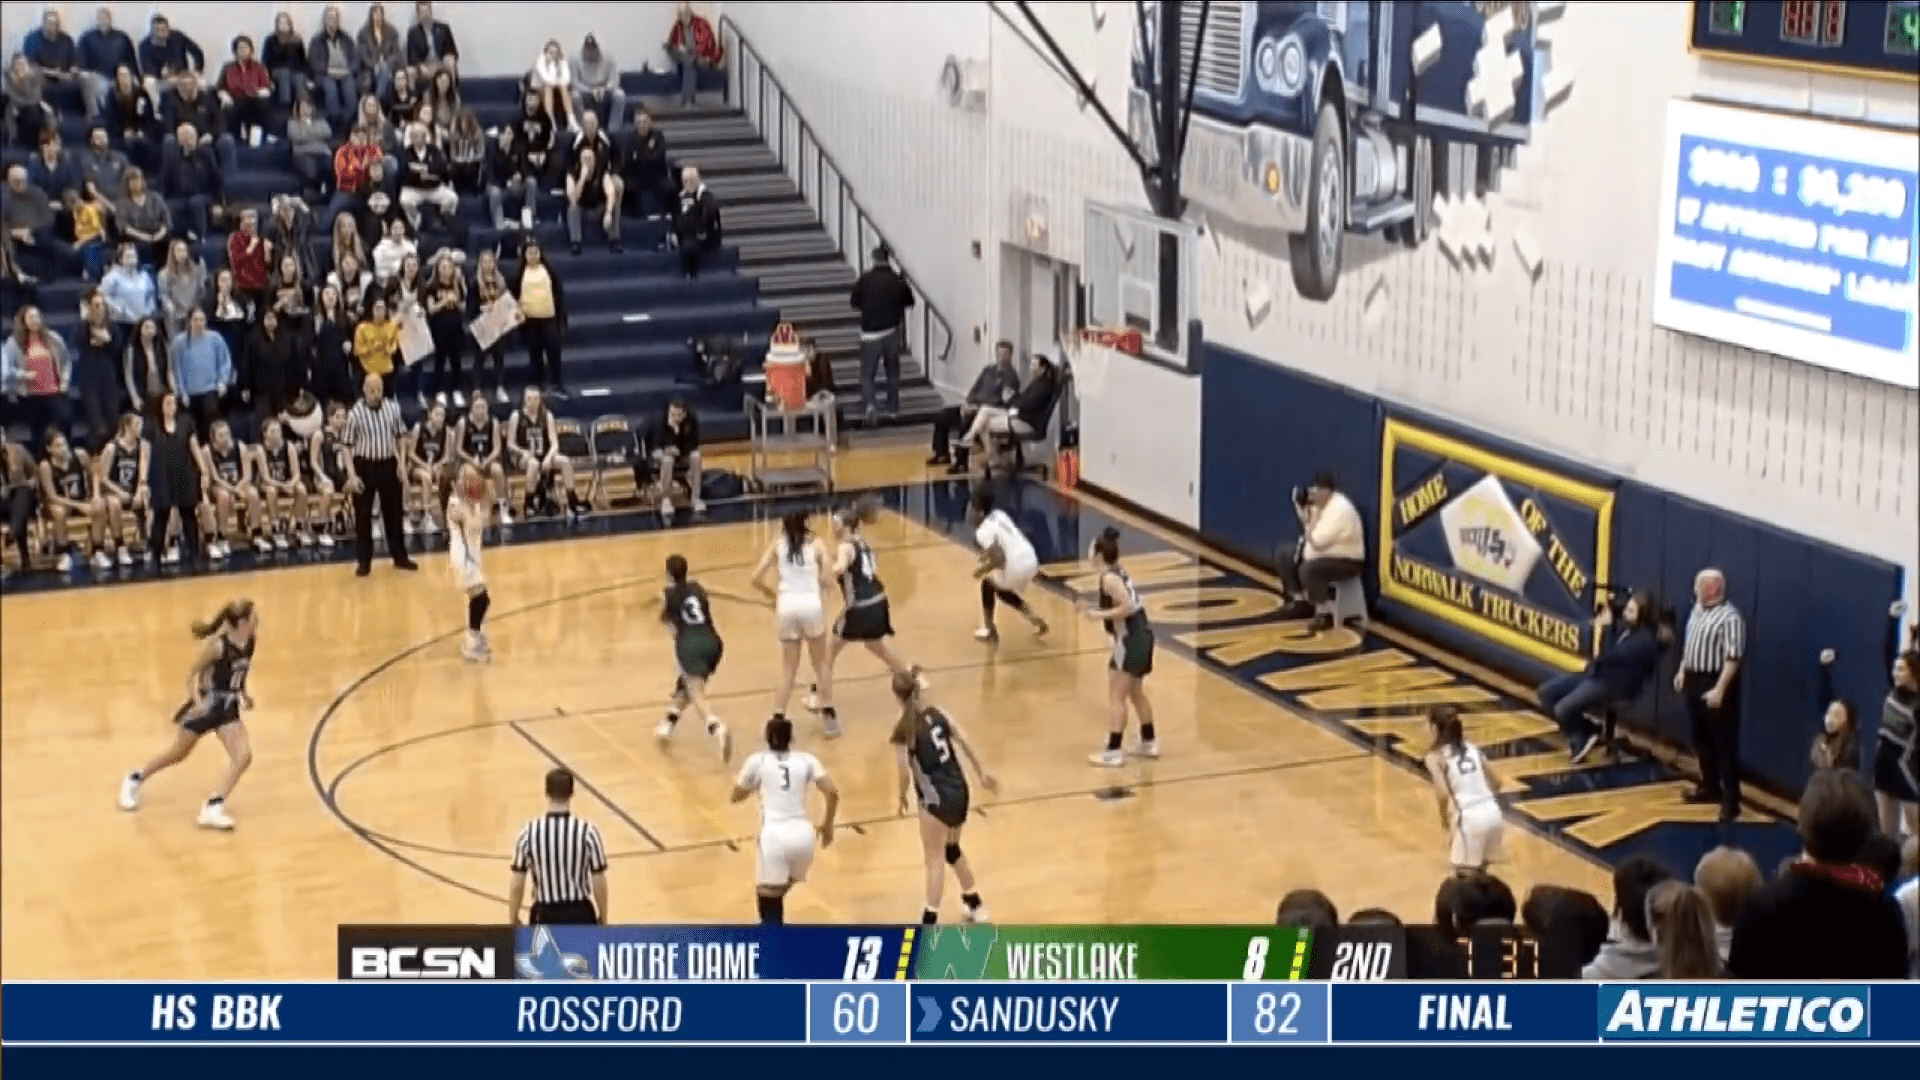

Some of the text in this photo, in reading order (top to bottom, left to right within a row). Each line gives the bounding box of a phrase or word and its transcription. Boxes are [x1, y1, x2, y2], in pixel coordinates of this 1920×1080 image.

[1399, 470, 1448, 524] HOME
[1521, 498, 1588, 598] OF THE
[680, 594, 706, 624] 3
[1394, 555, 1580, 651] NORWALK TRUCKERS
[929, 724, 950, 764] 5
[778, 764, 791, 791] 3
